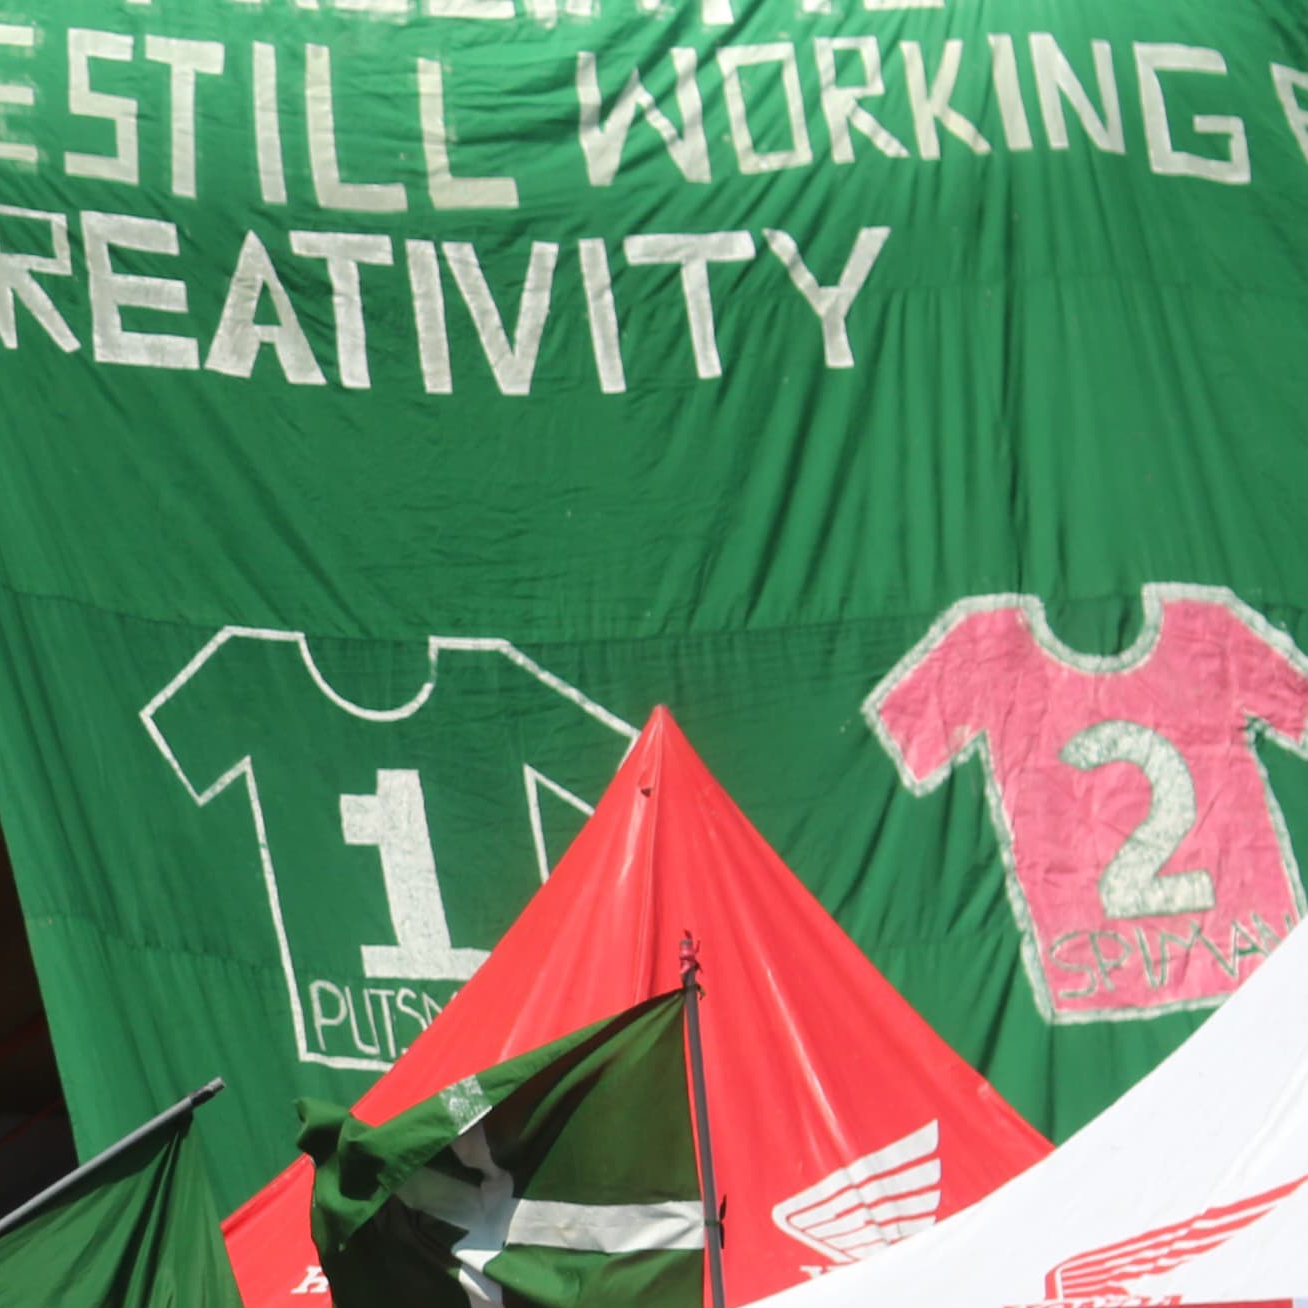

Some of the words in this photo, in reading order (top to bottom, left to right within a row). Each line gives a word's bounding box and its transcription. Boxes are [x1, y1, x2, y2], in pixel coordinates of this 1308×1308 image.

[64, 28, 521, 212] STILL
[575, 32, 1251, 186] WORKING
[339, 769, 492, 980] 1
[1057, 720, 1215, 919] 2
